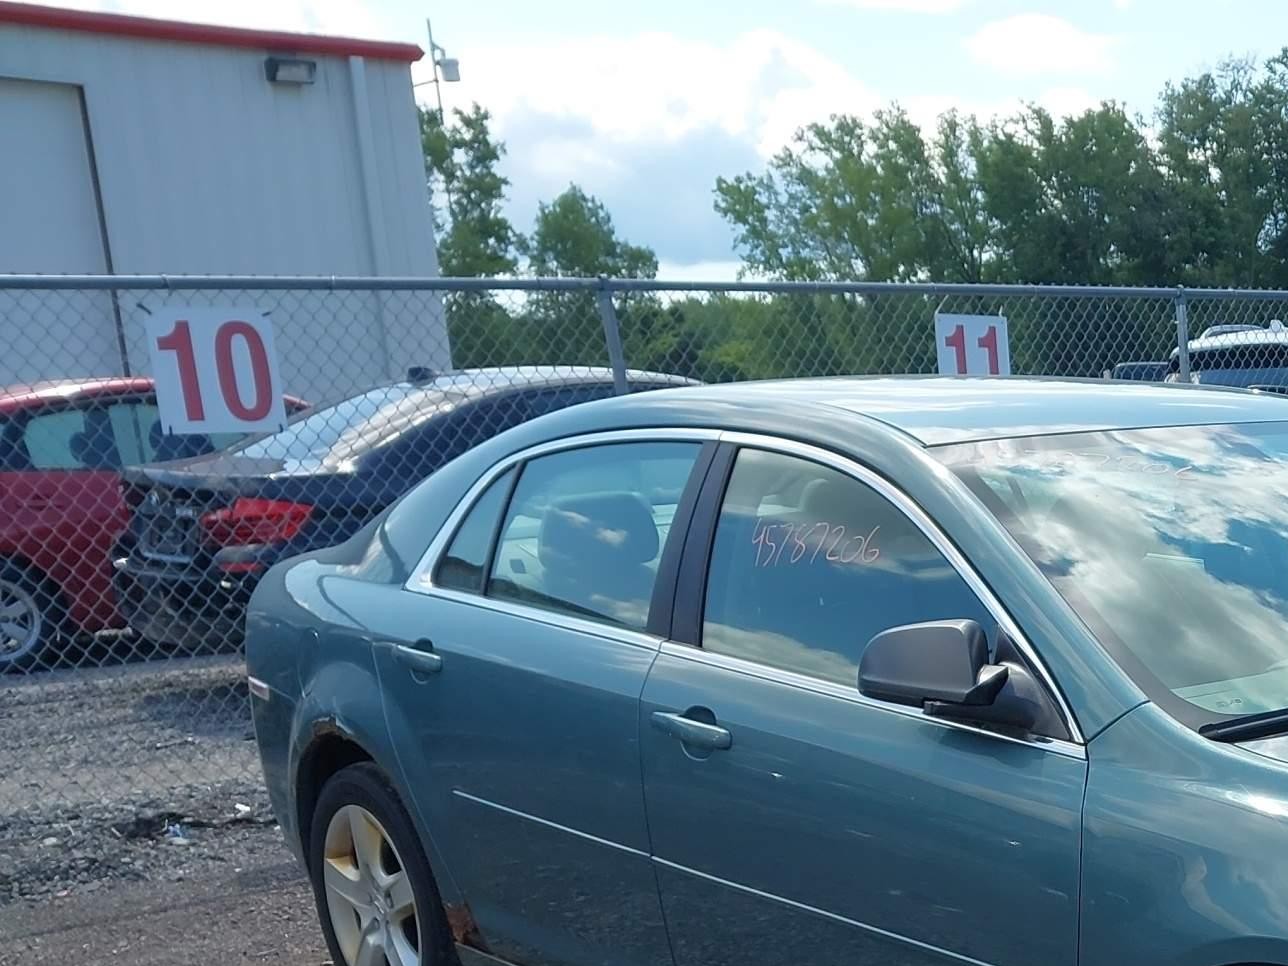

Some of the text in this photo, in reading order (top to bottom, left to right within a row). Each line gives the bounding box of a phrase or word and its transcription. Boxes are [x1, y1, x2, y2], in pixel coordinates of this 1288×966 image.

[156, 319, 272, 422] 10
[945, 324, 999, 375] 11
[751, 517, 881, 568] 45787206
